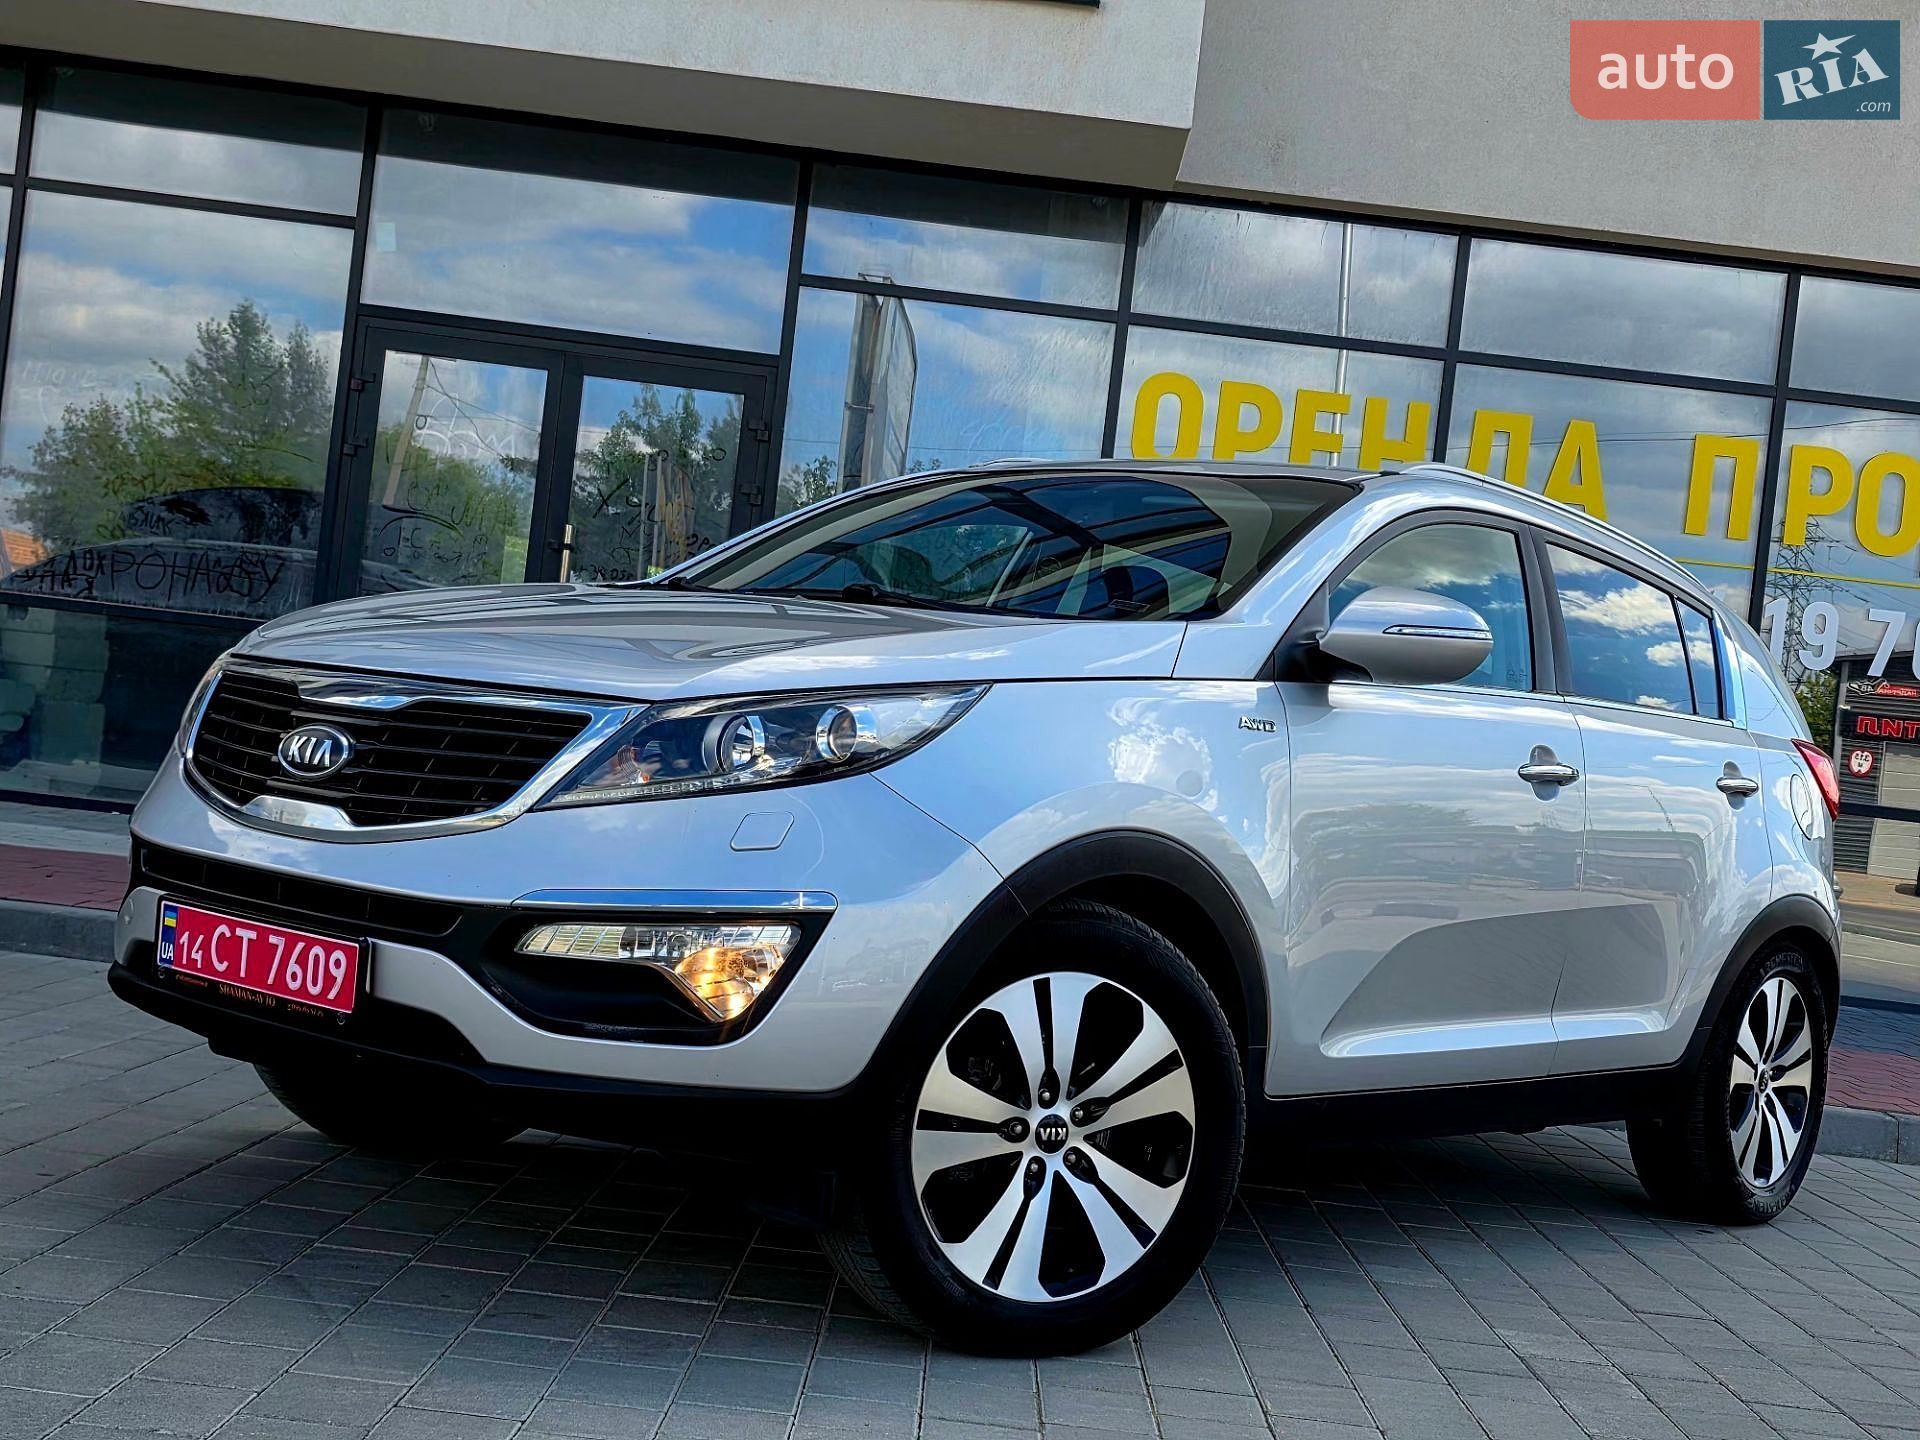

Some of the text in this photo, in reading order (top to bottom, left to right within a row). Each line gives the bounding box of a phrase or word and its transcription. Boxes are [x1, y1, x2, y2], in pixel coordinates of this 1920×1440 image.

[1684, 433, 1920, 557] ПРО
[1867, 609, 1920, 681] 7
[1238, 716, 1276, 733] AWD
[287, 735, 333, 768] KIA
[161, 941, 174, 961] UA
[179, 924, 347, 1000] 14 CT 7609
[1040, 1127, 1067, 1141] KIA
